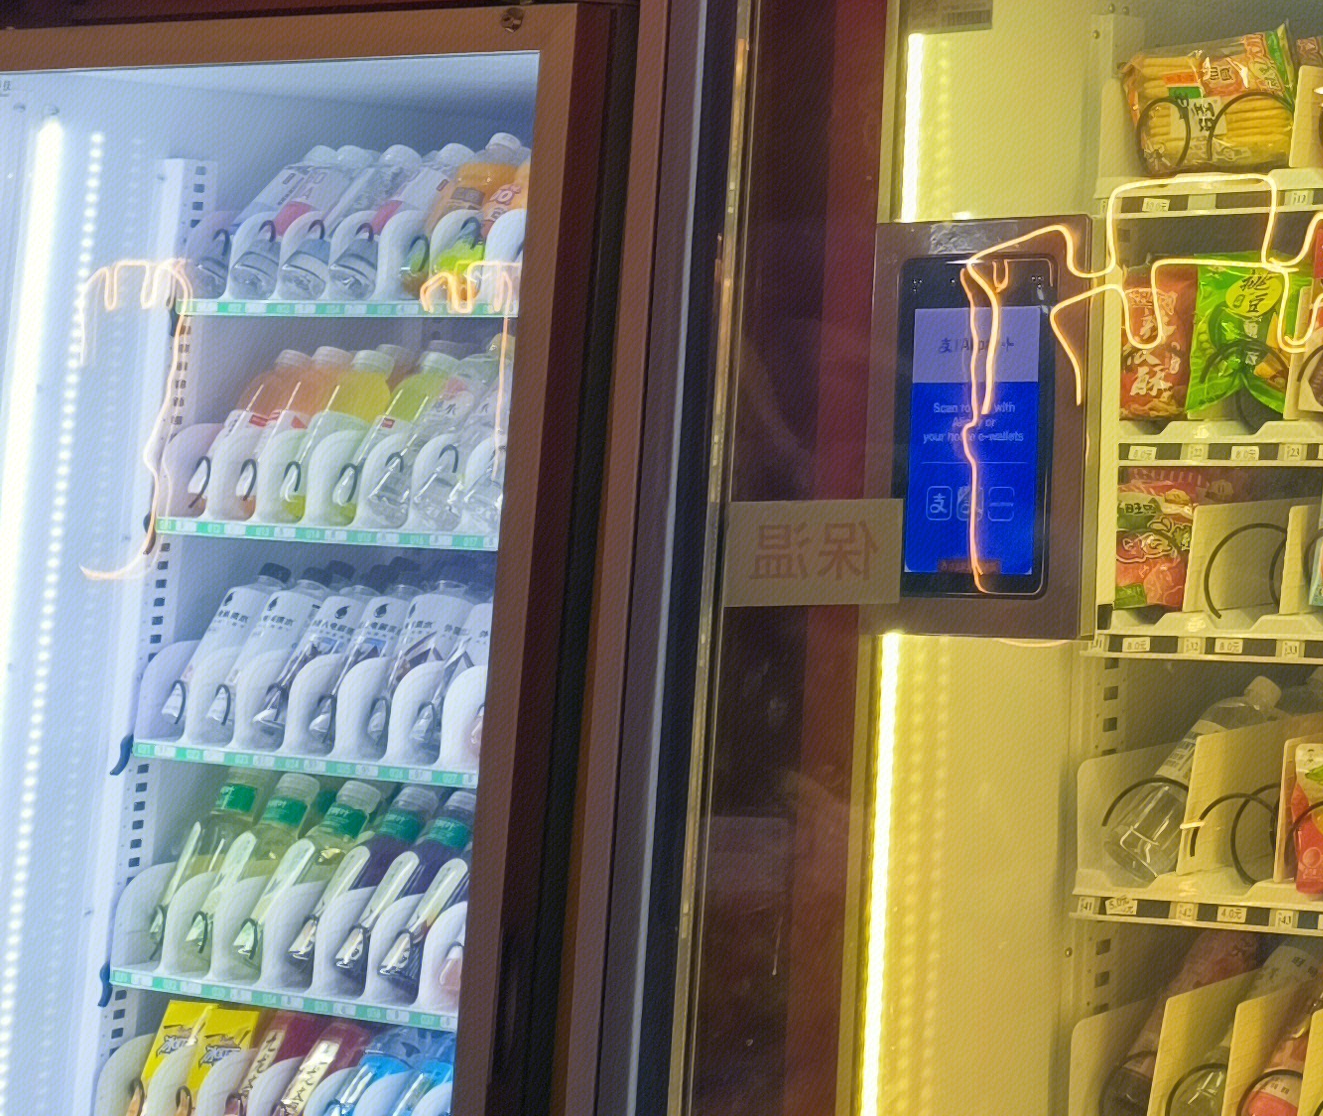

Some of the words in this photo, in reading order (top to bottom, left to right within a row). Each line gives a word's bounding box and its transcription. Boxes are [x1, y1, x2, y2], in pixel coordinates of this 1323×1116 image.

[933, 403, 959, 414] Scan
[994, 403, 1016, 414] with
[923, 432, 945, 444] your
[978, 430, 1024, 442] e-wallets
